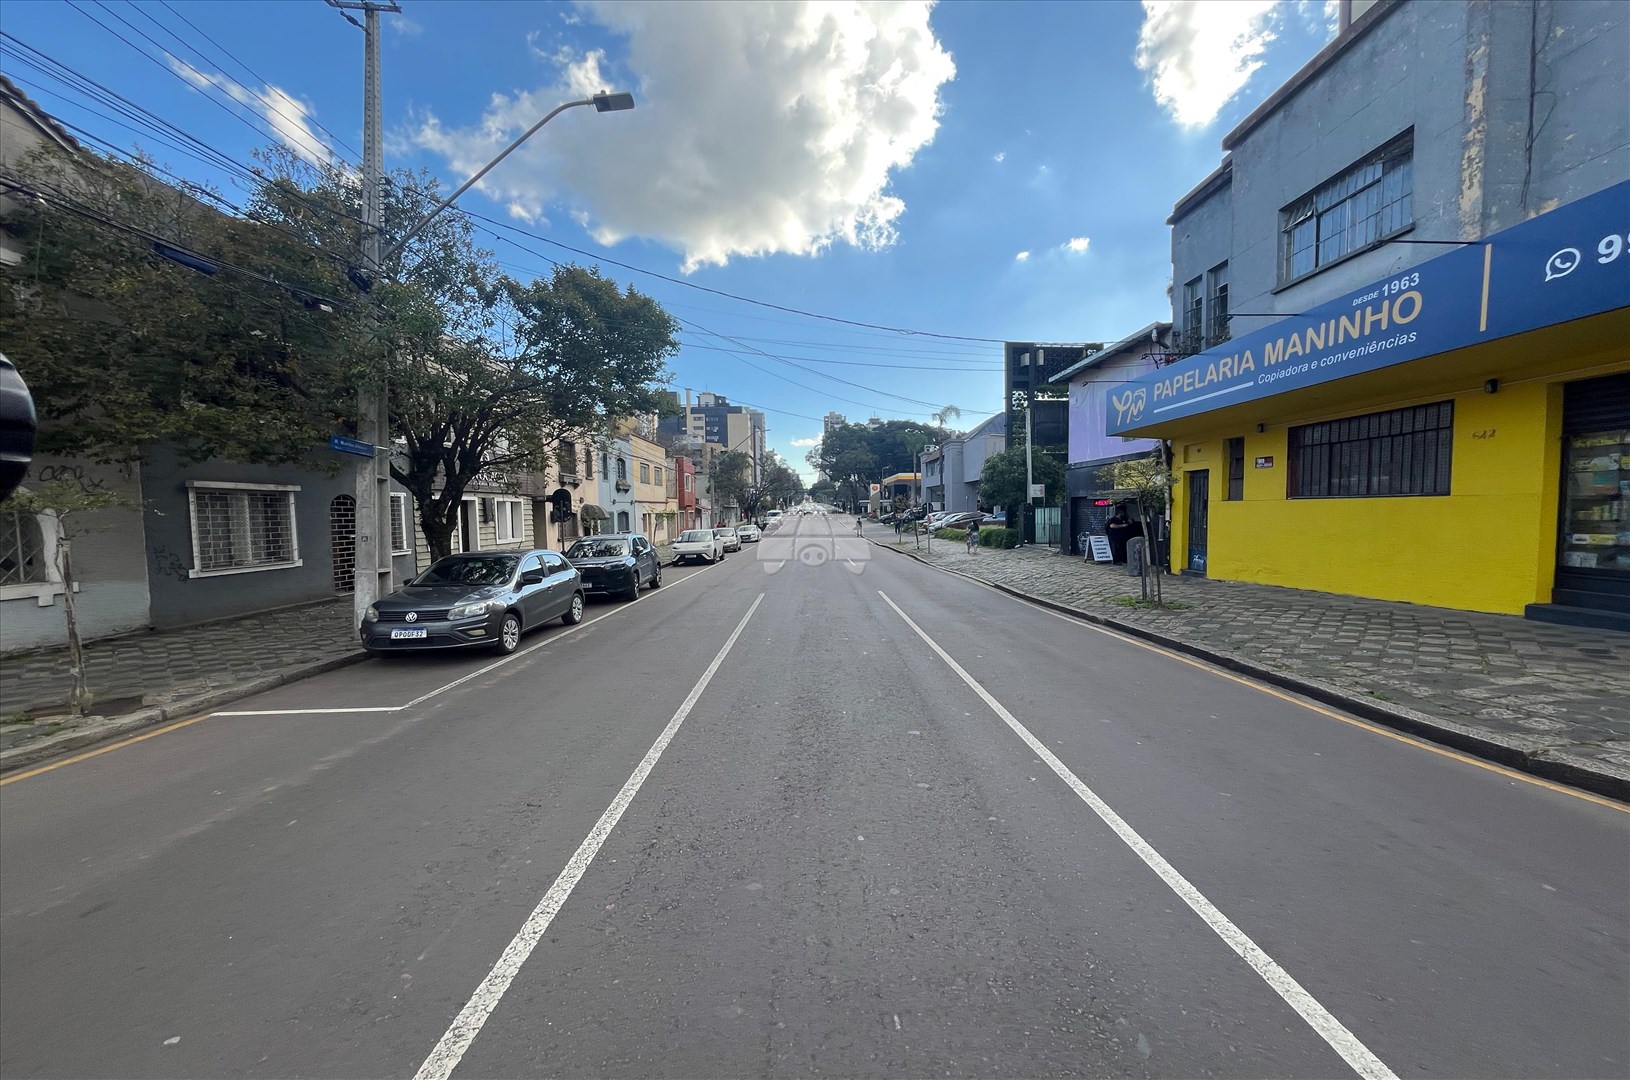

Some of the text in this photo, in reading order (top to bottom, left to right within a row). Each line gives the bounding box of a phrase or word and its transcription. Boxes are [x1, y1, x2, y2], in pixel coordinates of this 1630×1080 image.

[1352, 272, 1420, 307] DESDE 1963
[1153, 290, 1423, 402] PAPELARIA MANINHO
[1258, 331, 1417, 385] Copiadora e conveniências
